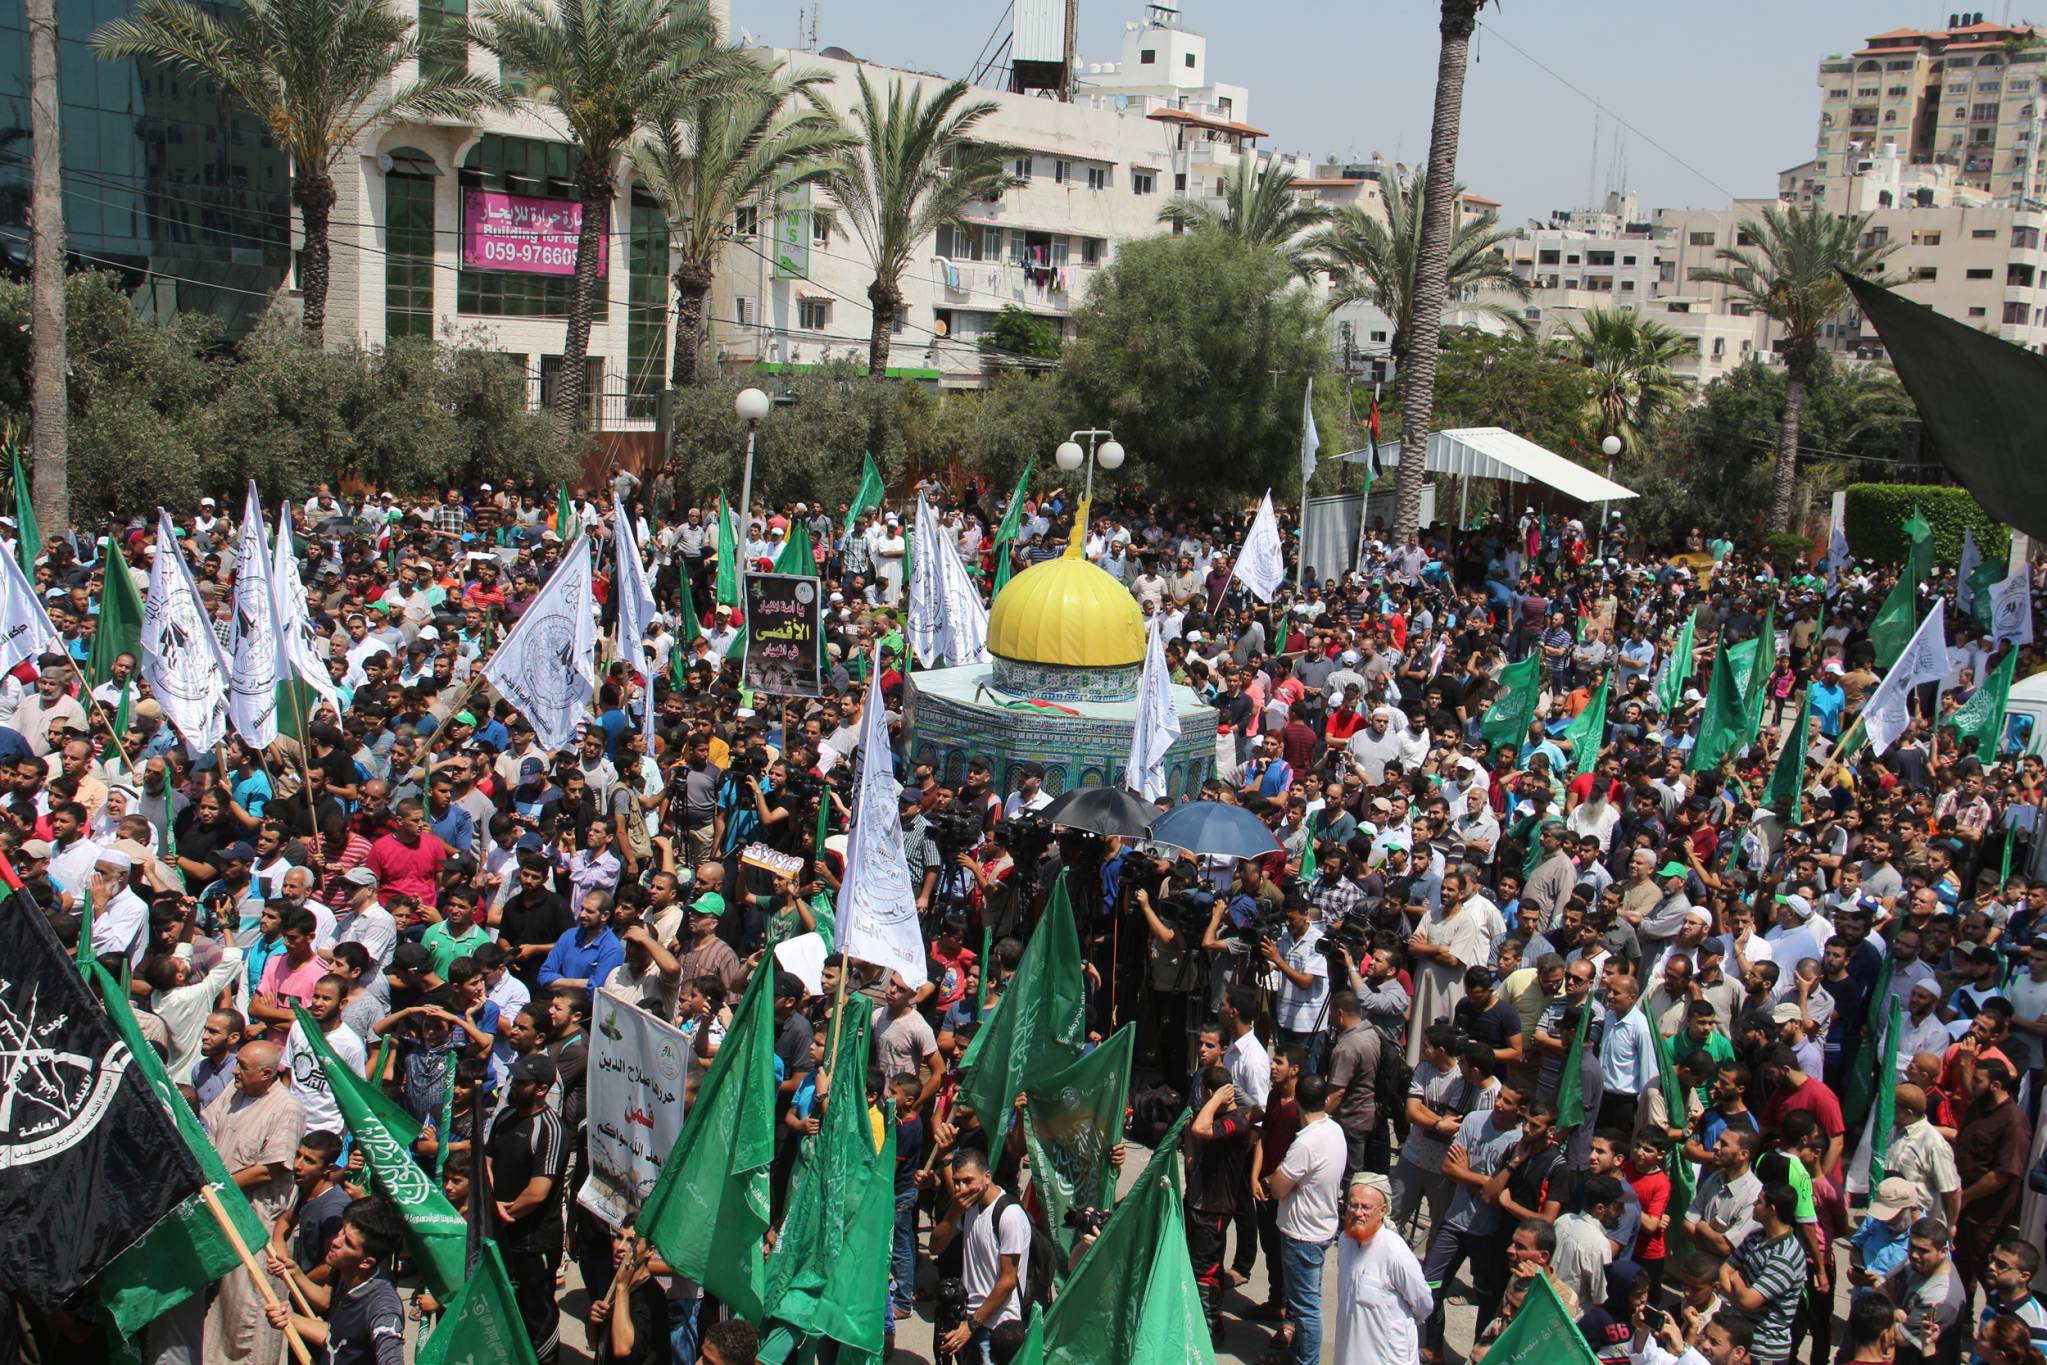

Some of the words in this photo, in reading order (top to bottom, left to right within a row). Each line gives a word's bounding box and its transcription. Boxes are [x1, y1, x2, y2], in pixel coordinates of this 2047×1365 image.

[531, 207, 561, 228] حرارة
[483, 223, 538, 243] Building
[542, 230, 559, 242] for
[564, 231, 579, 245] Re
[755, 618, 810, 641] الأقصى
[36, 1014, 68, 1036] عودة
[598, 1051, 626, 1073] الدين
[627, 1066, 651, 1088] صلاح
[70, 1074, 94, 1111] القيادة
[624, 1095, 656, 1130] فمن
[18, 1117, 60, 1137] العامة
[597, 1122, 628, 1147] سواكم
[629, 1136, 644, 1156] الله
[1604, 1323, 1630, 1343] 56
